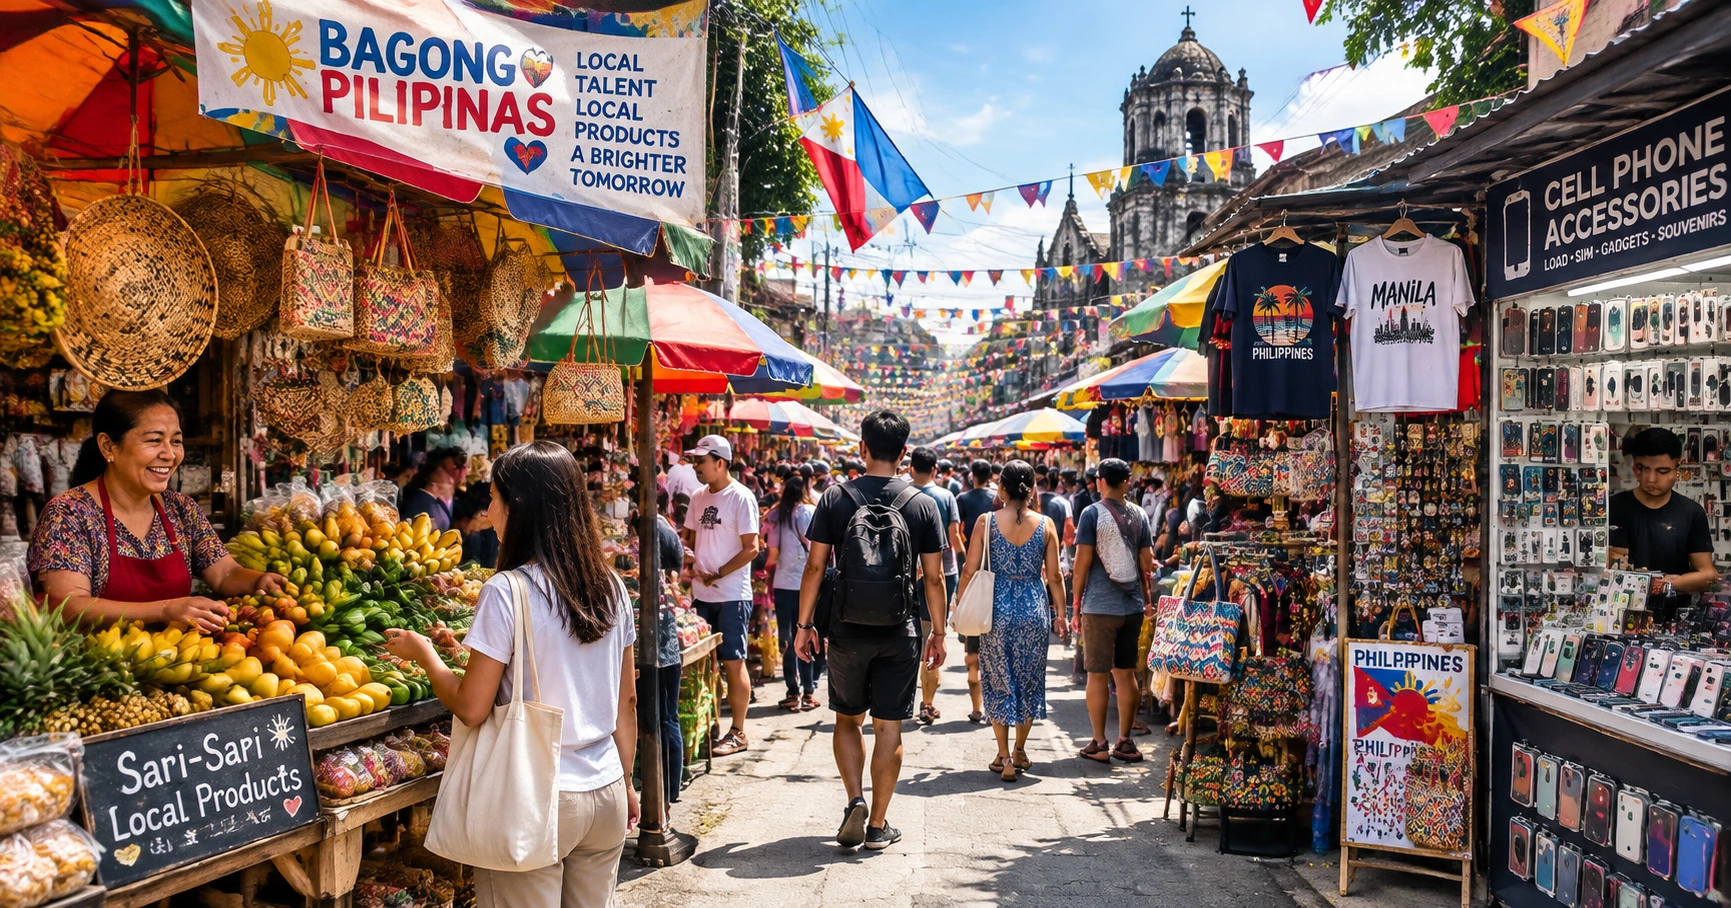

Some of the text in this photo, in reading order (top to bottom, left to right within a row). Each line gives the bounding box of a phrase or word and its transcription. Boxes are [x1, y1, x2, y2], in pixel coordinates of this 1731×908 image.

[318, 18, 517, 87] BAGONG
[576, 51, 645, 73] LOCAL
[575, 75, 658, 98] TALENT
[320, 69, 556, 138] PILIPINAS
[575, 99, 644, 122] LOCAL
[574, 121, 681, 149] PRODUCTS
[570, 144, 687, 175] A BRIGHTER
[1544, 115, 1726, 212] CELL PHONE
[570, 168, 686, 199] TOMORROW
[1544, 162, 1728, 251] ACCESSORIES
[1544, 254, 1568, 272] LOAD
[1601, 231, 1649, 257] GADGETS
[1657, 209, 1727, 241] SOUVENIRS
[1252, 347, 1314, 360] PHILIPPINES
[108, 790, 191, 843] Local
[196, 763, 303, 820] Products
